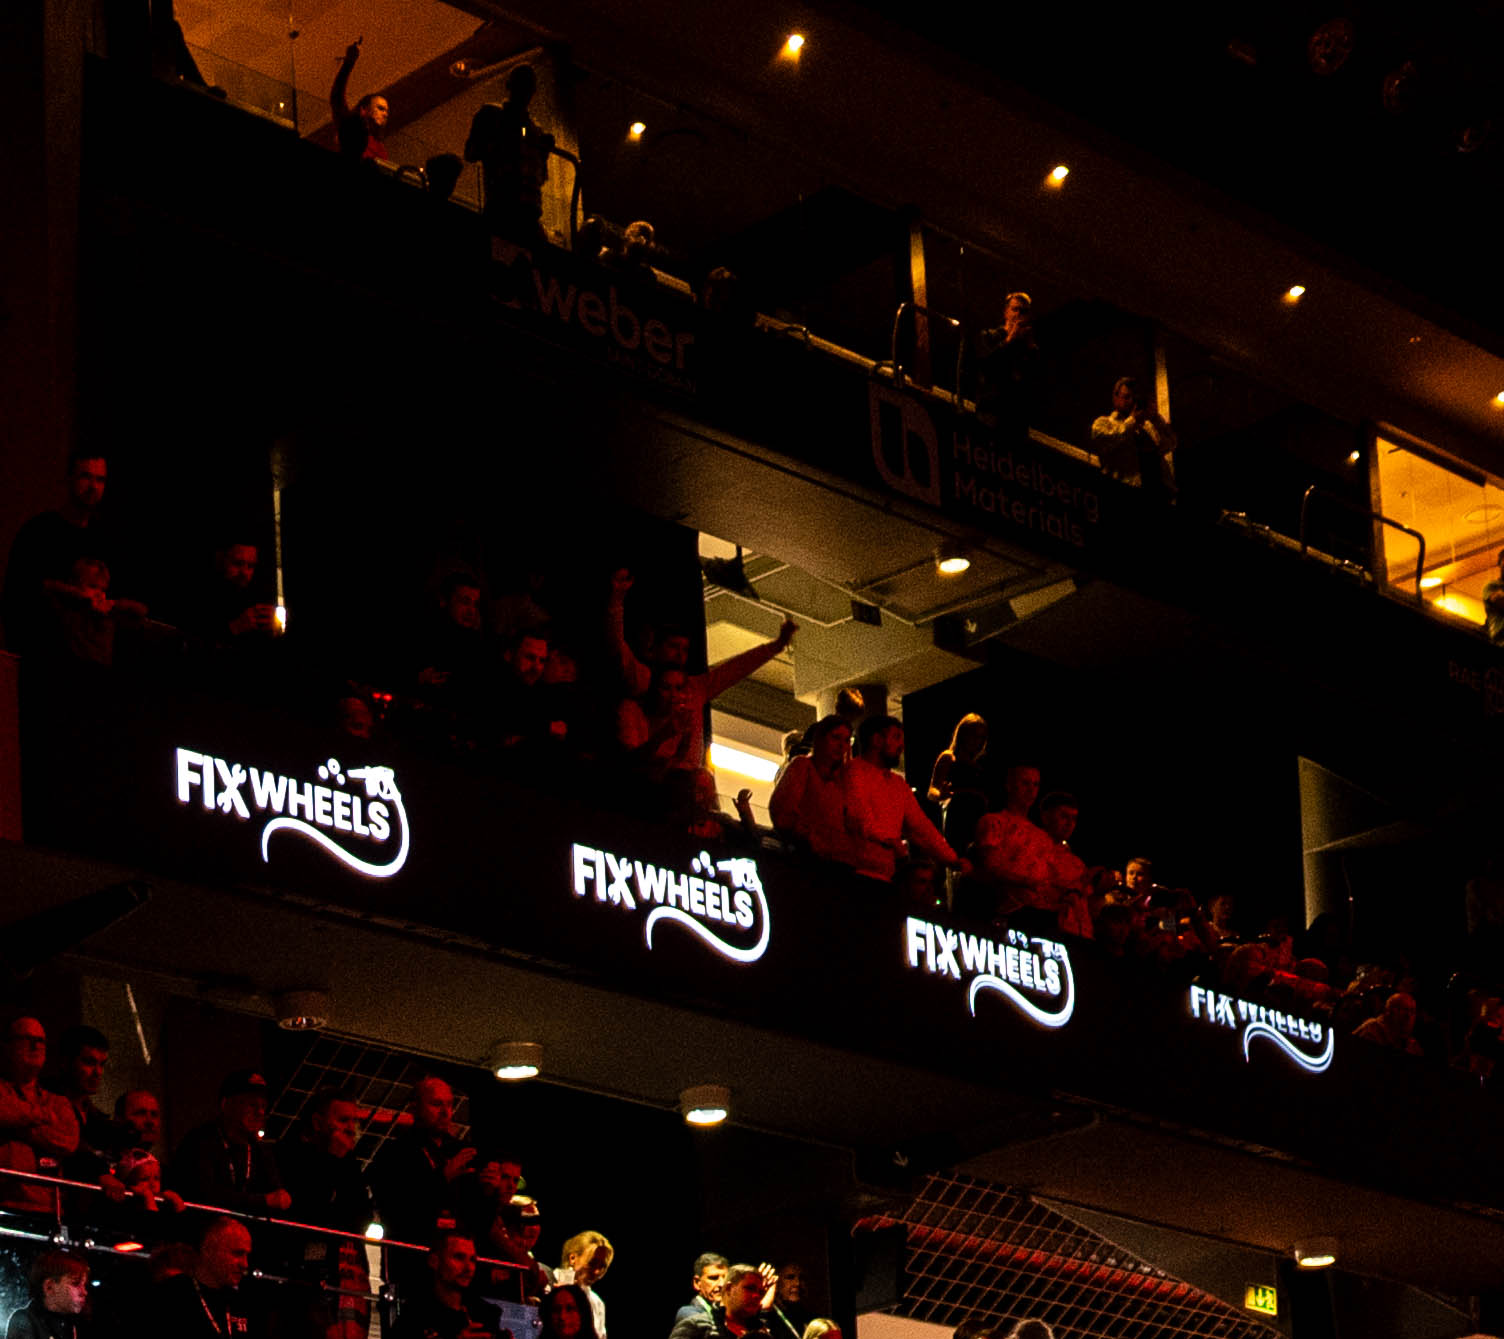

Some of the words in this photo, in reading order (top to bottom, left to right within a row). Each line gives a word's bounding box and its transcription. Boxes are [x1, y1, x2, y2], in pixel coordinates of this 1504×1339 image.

[532, 269, 695, 370] weber
[952, 473, 1086, 548] Materials
[953, 432, 1099, 525] Heidelberg
